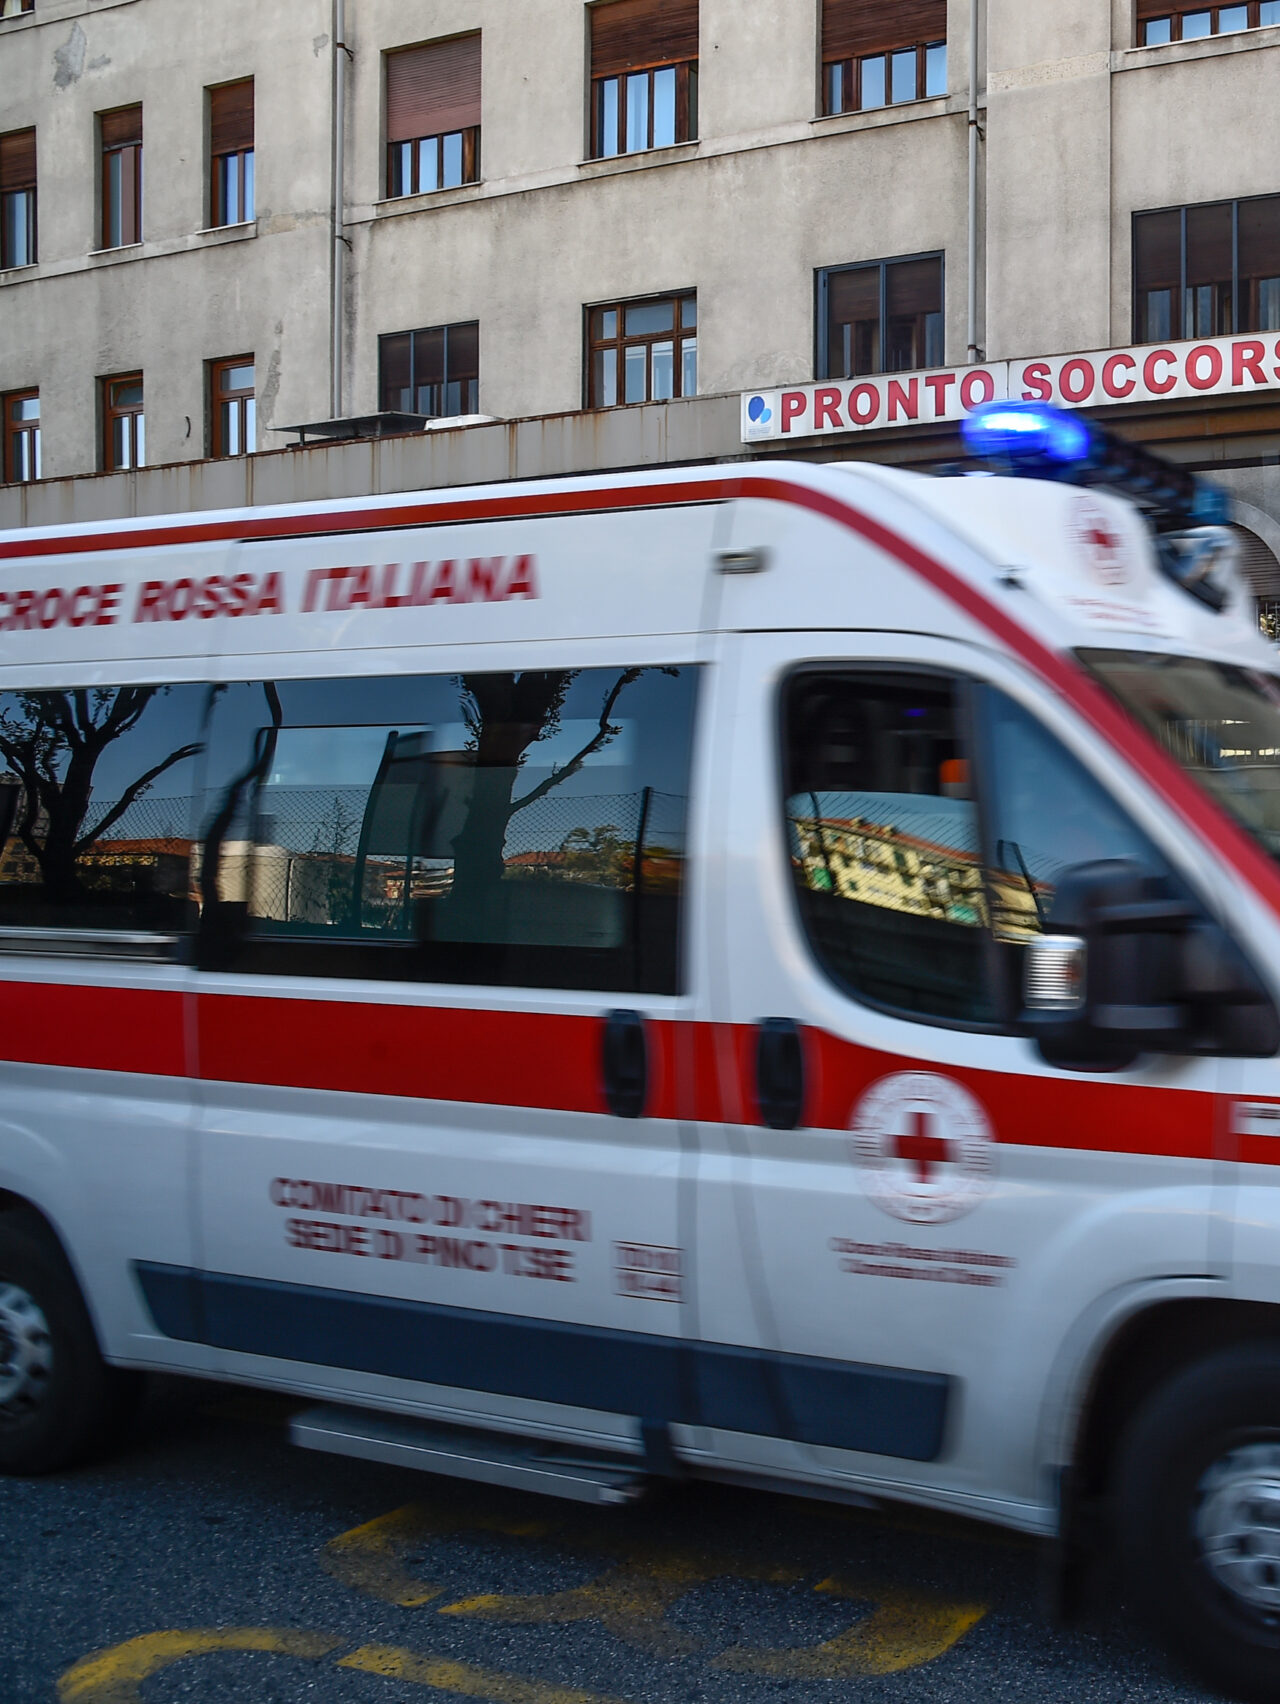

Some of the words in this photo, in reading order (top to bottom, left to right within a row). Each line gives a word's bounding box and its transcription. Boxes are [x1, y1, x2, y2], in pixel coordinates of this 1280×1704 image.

[781, 369, 995, 432] PRONTO
[133, 571, 285, 624] ROSSA
[300, 553, 540, 613] ITALIANA
